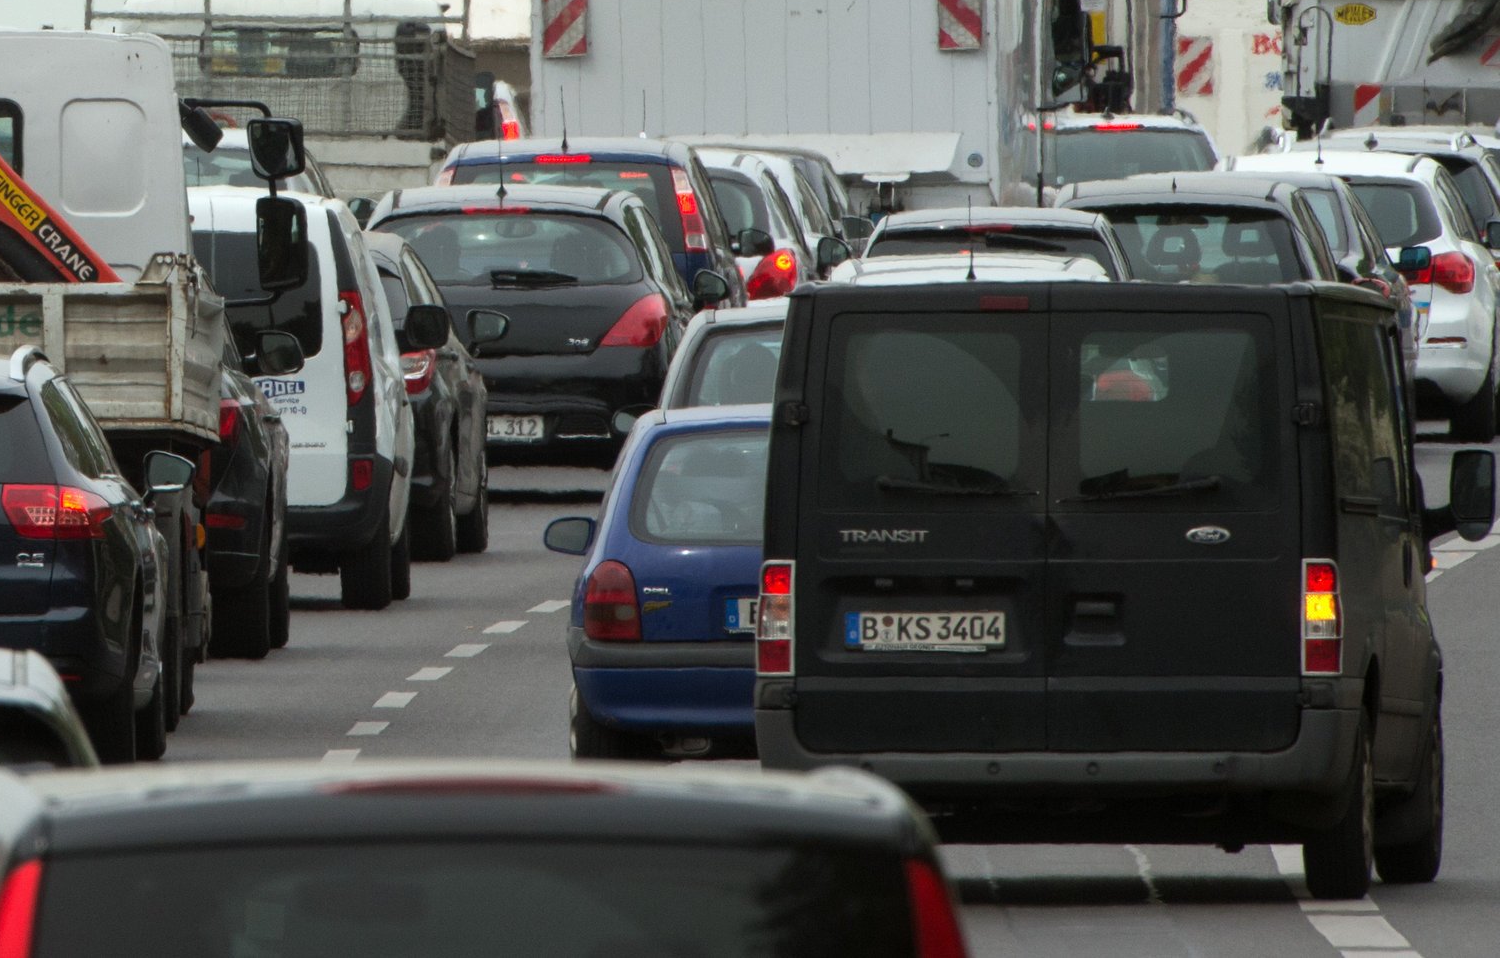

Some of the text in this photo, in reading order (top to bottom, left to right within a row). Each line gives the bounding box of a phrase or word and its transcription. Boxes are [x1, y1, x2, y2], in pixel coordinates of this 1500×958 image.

[38, 223, 93, 281] CRANE
[504, 417, 538, 437] 312
[839, 529, 930, 542] TRANSIT
[862, 615, 1002, 641] B KS 3404
